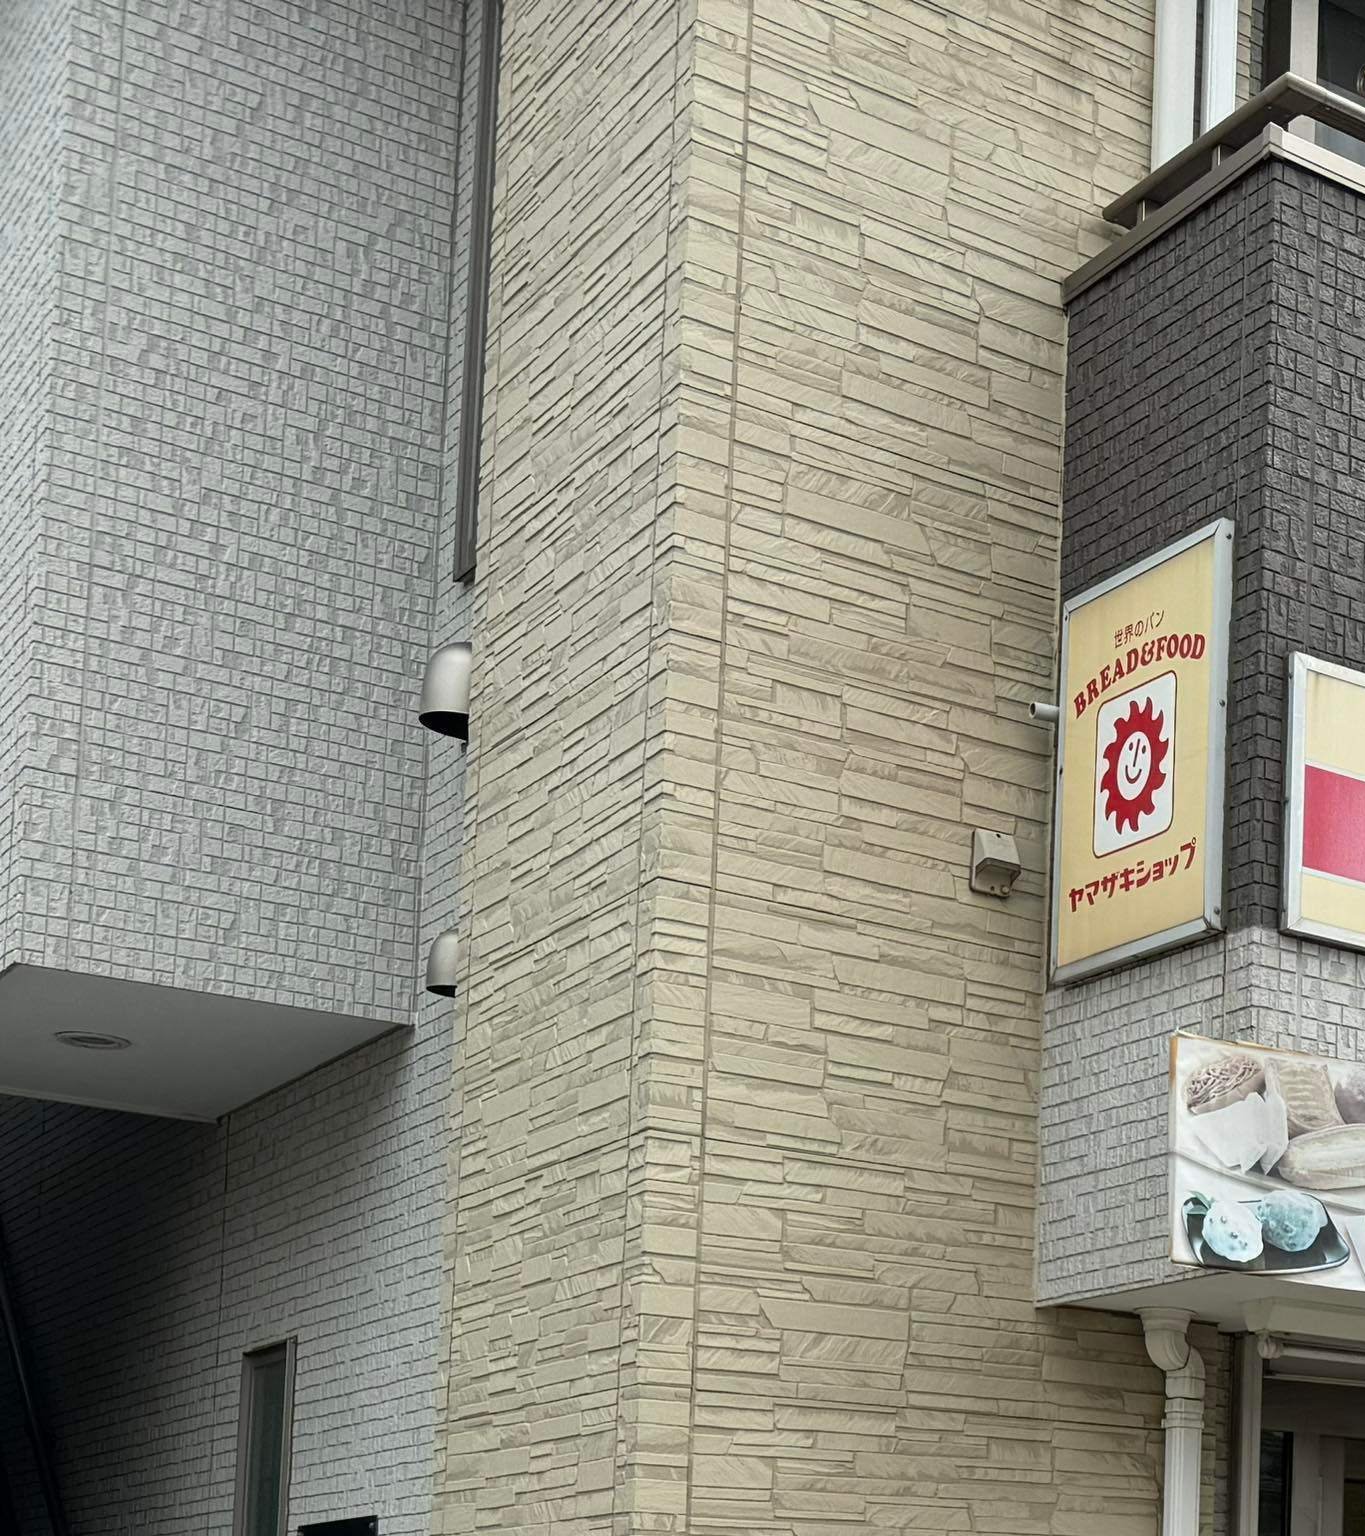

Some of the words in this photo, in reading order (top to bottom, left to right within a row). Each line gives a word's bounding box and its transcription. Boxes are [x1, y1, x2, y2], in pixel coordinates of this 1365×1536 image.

[1113, 609, 1165, 649] 世界のパン
[1073, 632, 1206, 719] BREAD&FOOD
[1068, 837, 1197, 913] ヤマザキショップ
